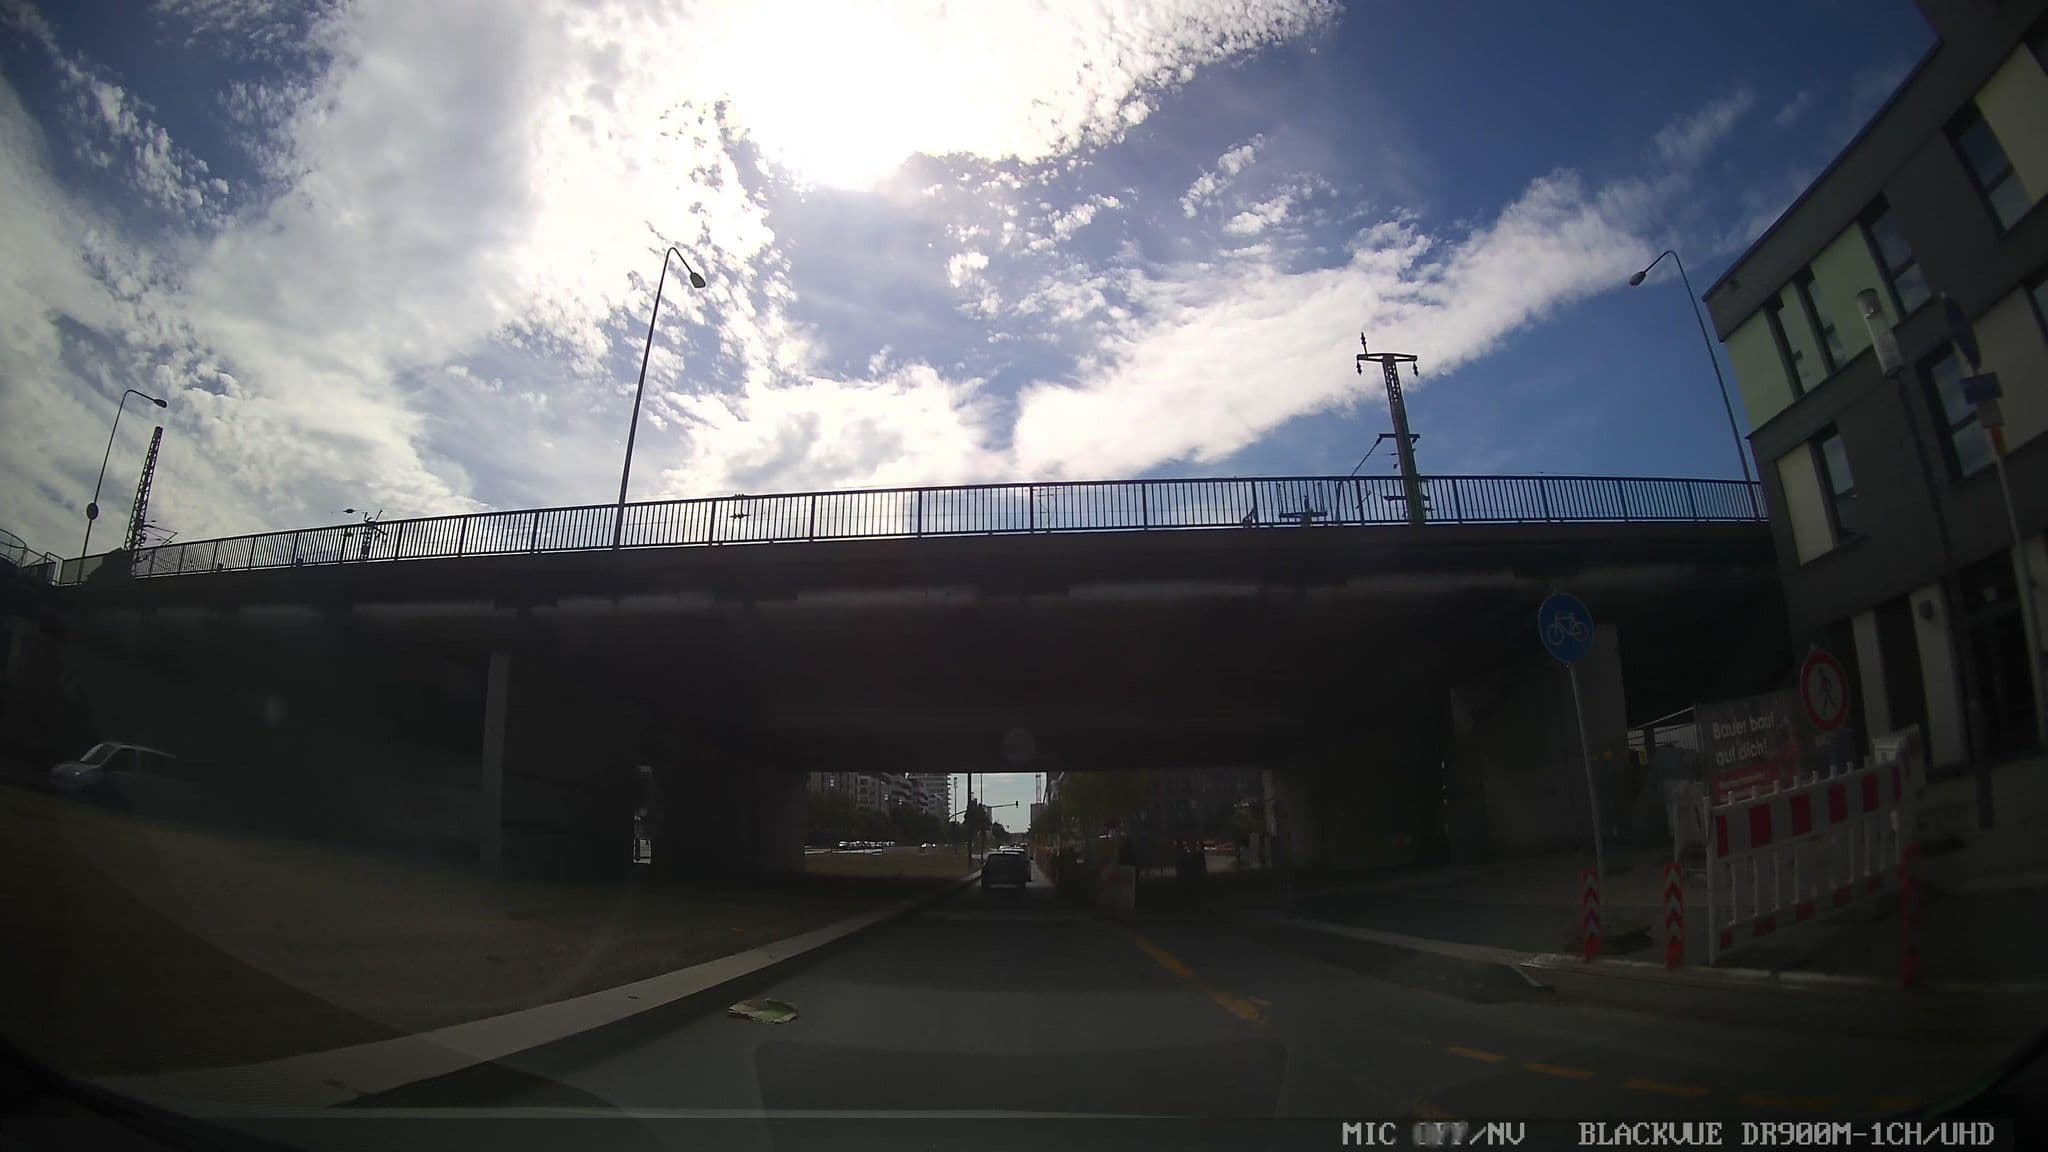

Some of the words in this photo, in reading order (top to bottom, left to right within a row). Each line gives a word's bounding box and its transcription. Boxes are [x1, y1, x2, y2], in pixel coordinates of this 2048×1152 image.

[1712, 718, 1747, 740] Bauer
[1716, 744, 1737, 766] auf
[1738, 737, 1768, 760] dich!
